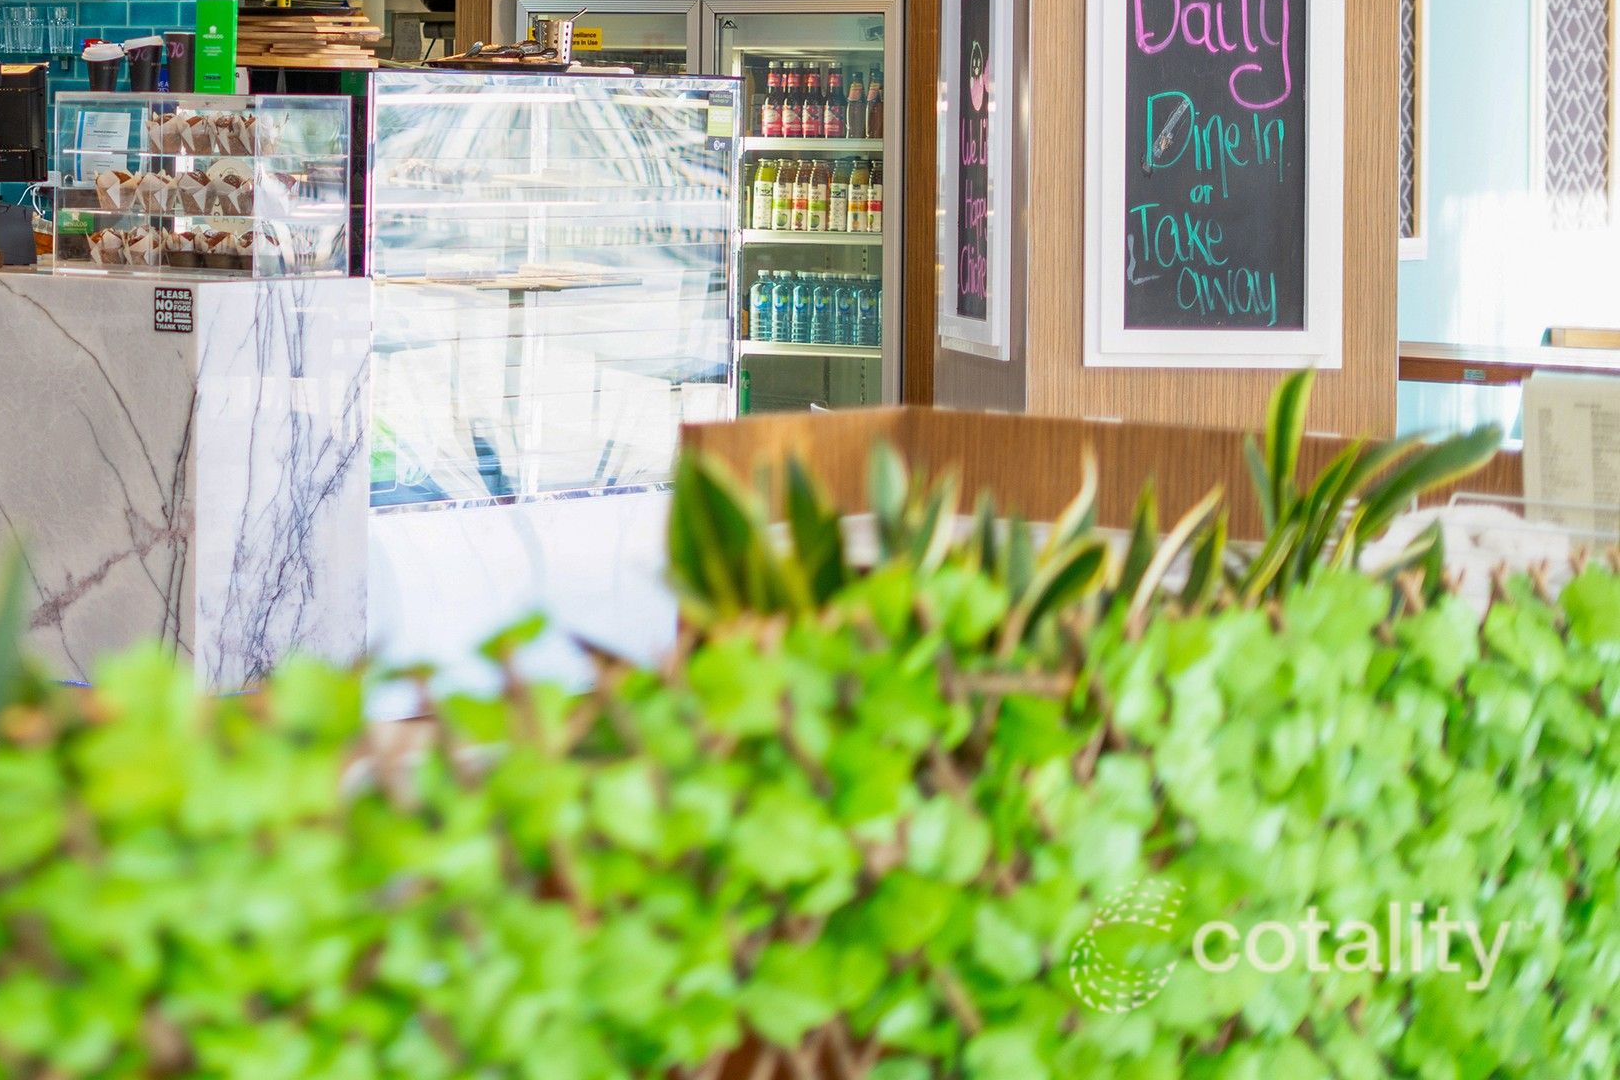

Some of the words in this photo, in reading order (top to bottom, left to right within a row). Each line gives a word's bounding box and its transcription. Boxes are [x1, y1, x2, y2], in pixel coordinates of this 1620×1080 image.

[1144, 90, 1249, 199] Dine
[1189, 183, 1214, 205] or
[1130, 202, 1229, 269] Take
[155, 299, 174, 311] NO
[155, 310, 174, 323] OR
[1176, 266, 1278, 328] away
